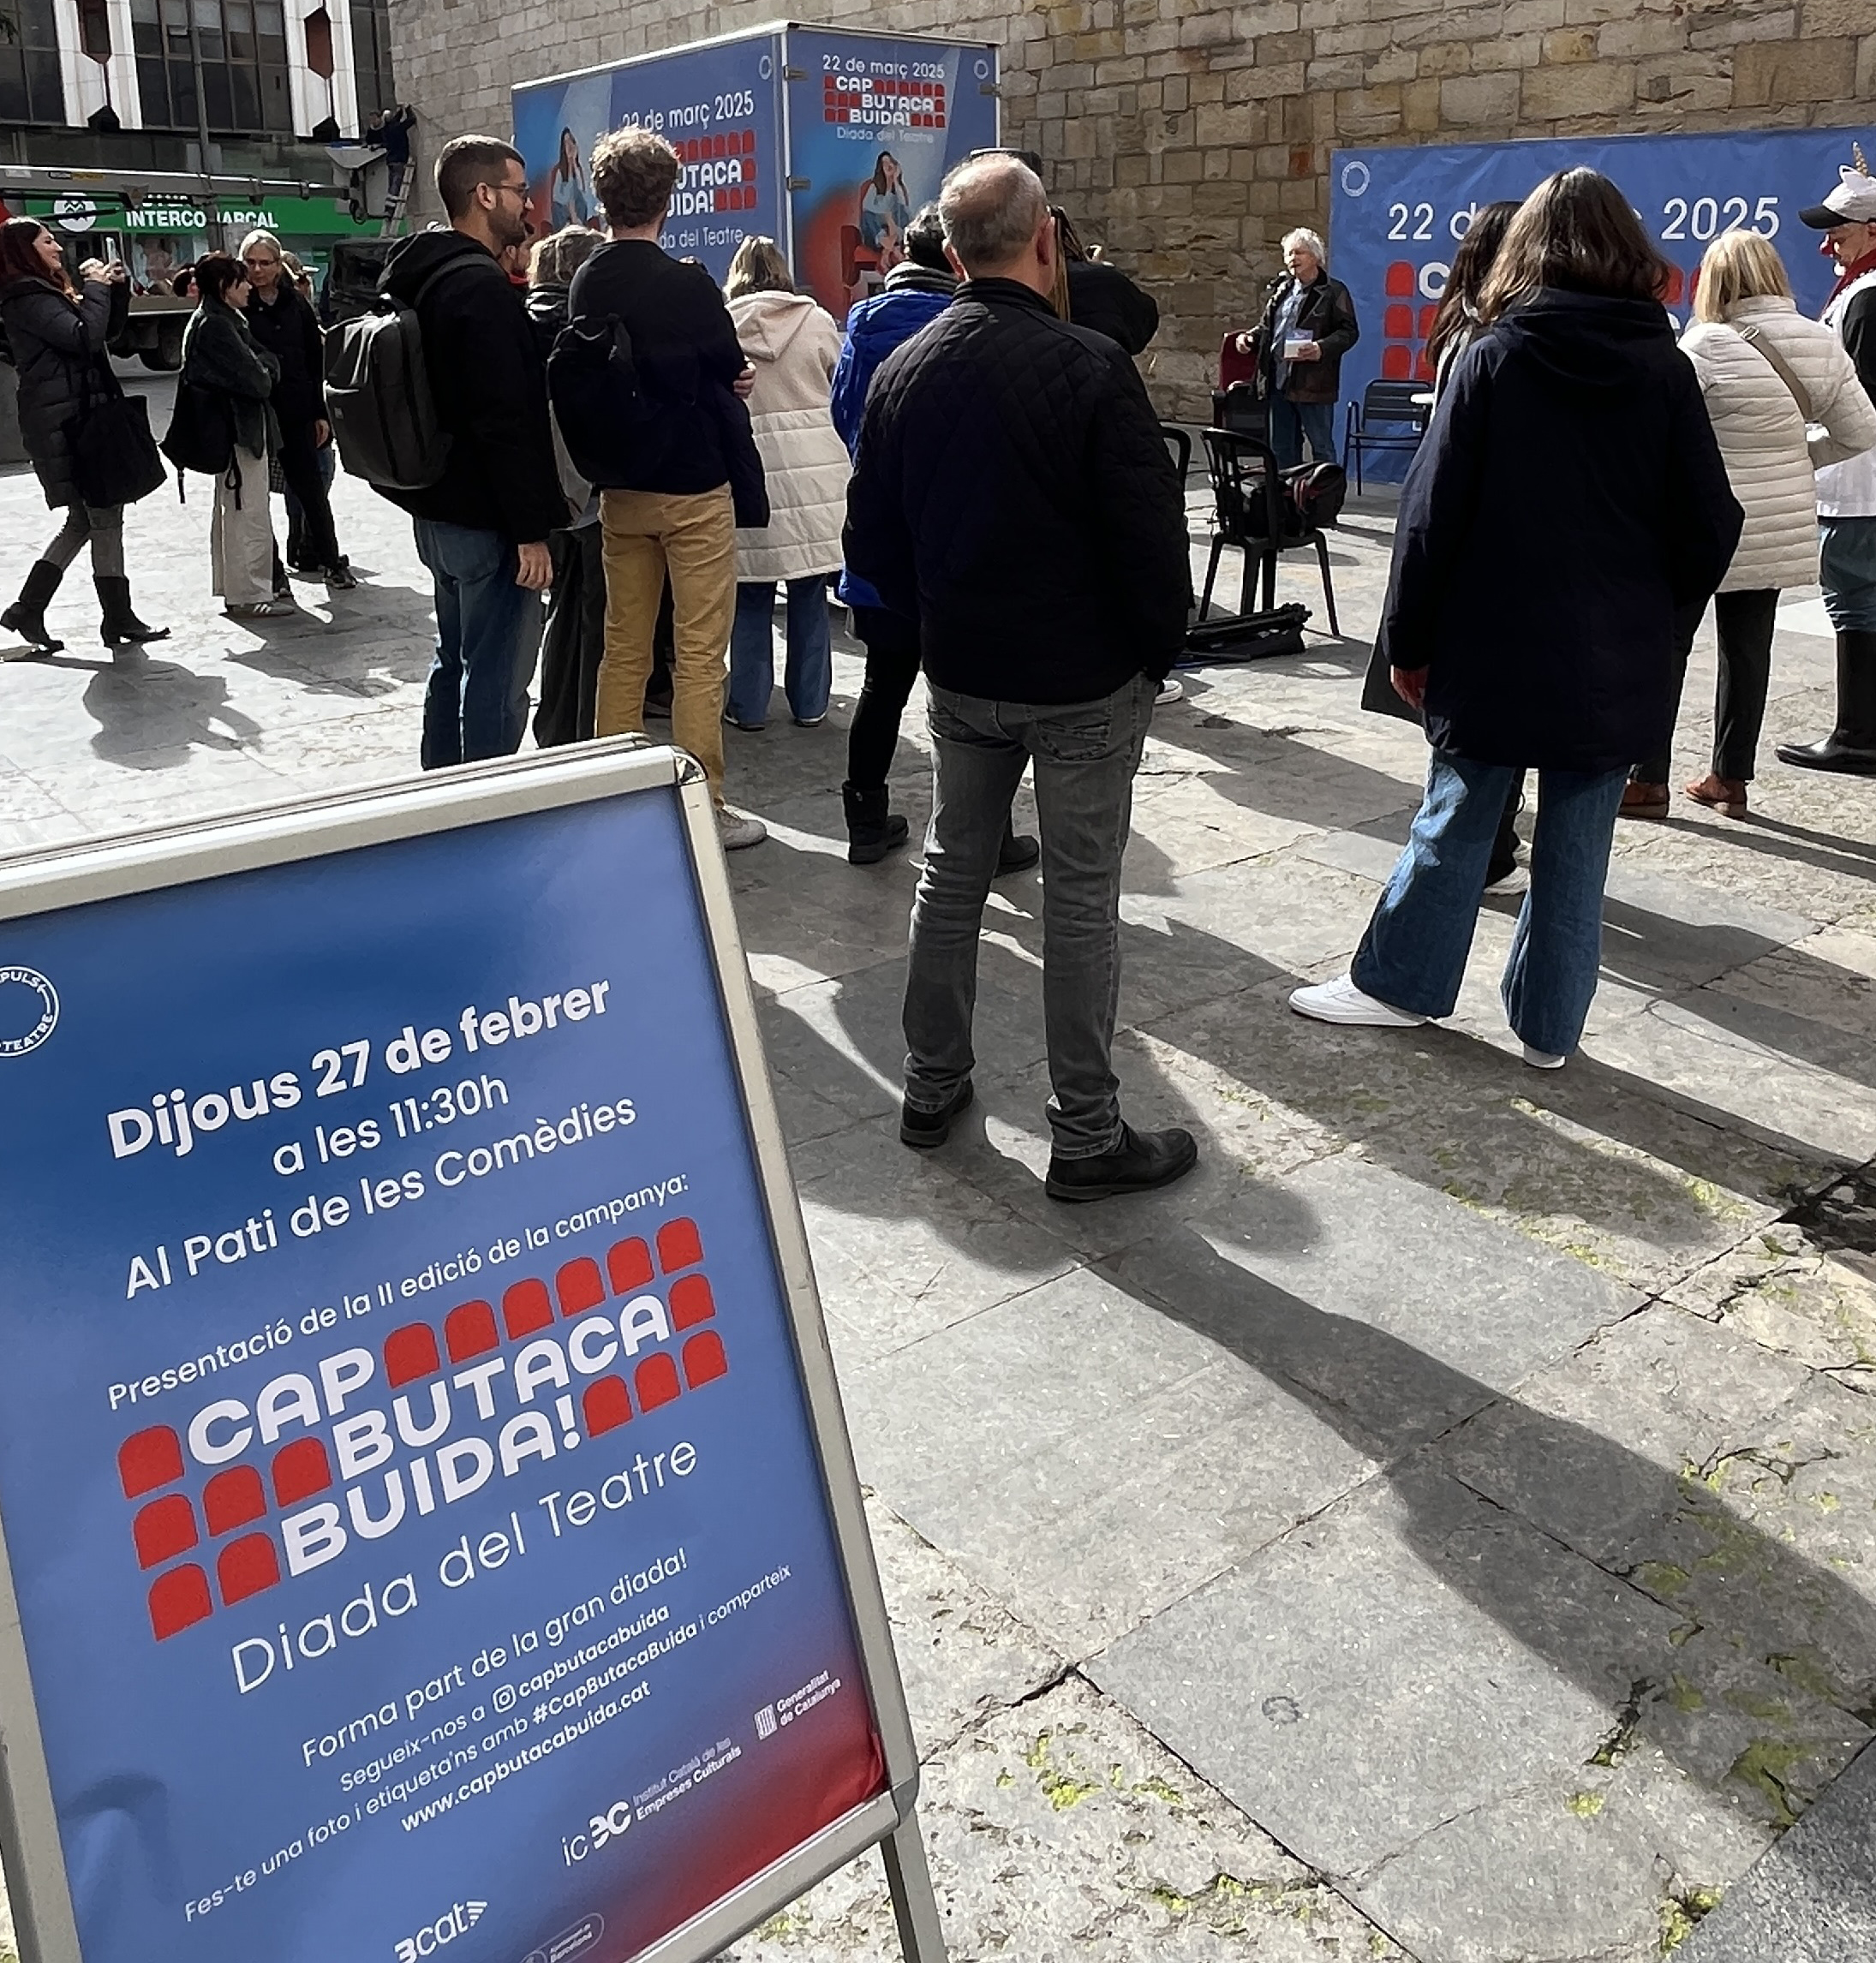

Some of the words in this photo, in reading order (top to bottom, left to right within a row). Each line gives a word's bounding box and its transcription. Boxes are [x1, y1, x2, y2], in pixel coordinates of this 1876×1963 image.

[644, 108, 665, 130] de
[668, 103, 710, 130] març
[714, 90, 754, 121] 2025
[822, 54, 841, 72] 22
[845, 57, 865, 74] de
[869, 61, 908, 80] març
[911, 62, 946, 80] 2025
[836, 75, 874, 92] CAP
[862, 93, 934, 112] BUTACA
[836, 126, 874, 141] Diada
[849, 108, 911, 127] BUIDA!
[677, 158, 742, 190] UTACA
[126, 210, 279, 229] INTERCOARCAL
[678, 229, 699, 248] del
[702, 226, 744, 247] Teatre
[1387, 201, 1435, 241] 22
[1449, 202, 1476, 241] d
[1660, 197, 1780, 241] 2025
[107, 1072, 301, 1159] Dijous
[312, 1039, 369, 1097] 27
[386, 1026, 451, 1073] de
[460, 981, 609, 1053] febrer
[273, 1143, 304, 1174] a
[315, 1120, 380, 1162] les
[389, 1075, 508, 1137] 11:30h
[127, 1246, 170, 1298] Al
[184, 1209, 277, 1275] Pati
[291, 1196, 350, 1236] de
[361, 1172, 424, 1214] les
[435, 1099, 636, 1185] Comèdies
[109, 1318, 293, 1411] Presentació
[301, 1308, 337, 1334] de
[344, 1294, 372, 1319] la
[401, 1248, 482, 1298] edició
[489, 1239, 521, 1264] de
[525, 1227, 550, 1250] la
[556, 1173, 689, 1238] campanya:
[188, 1348, 374, 1464] CAP
[333, 1296, 669, 1480] BUTACA
[282, 1394, 581, 1578] BUIDA!
[232, 1573, 417, 1693] Diada
[440, 1512, 524, 1587] del
[539, 1442, 696, 1536] Teatre
[303, 1702, 397, 1767] Forma
[406, 1666, 465, 1720] part
[472, 1649, 506, 1676] de
[512, 1631, 539, 1657] la
[546, 1597, 605, 1647] gran
[611, 1548, 687, 1605] diada!
[341, 1715, 468, 1792] Segueix-nos
[472, 1706, 485, 1721] a
[519, 1605, 670, 1697] capbutacabuida
[186, 1869, 257, 1922] Fes-te
[262, 1841, 303, 1875] una
[308, 1815, 350, 1848] foto
[354, 1802, 361, 1821] i
[367, 1745, 478, 1814] etiqueta'ns
[482, 1718, 529, 1751] amb
[533, 1622, 697, 1725] #CapButacaBuida
[698, 1614, 706, 1631] i
[708, 1566, 792, 1626] comparteix
[402, 1680, 651, 1832] www.capbutacabuida.cat
[636, 1779, 692, 1821] Empreses
[693, 1746, 742, 1783] Culturals
